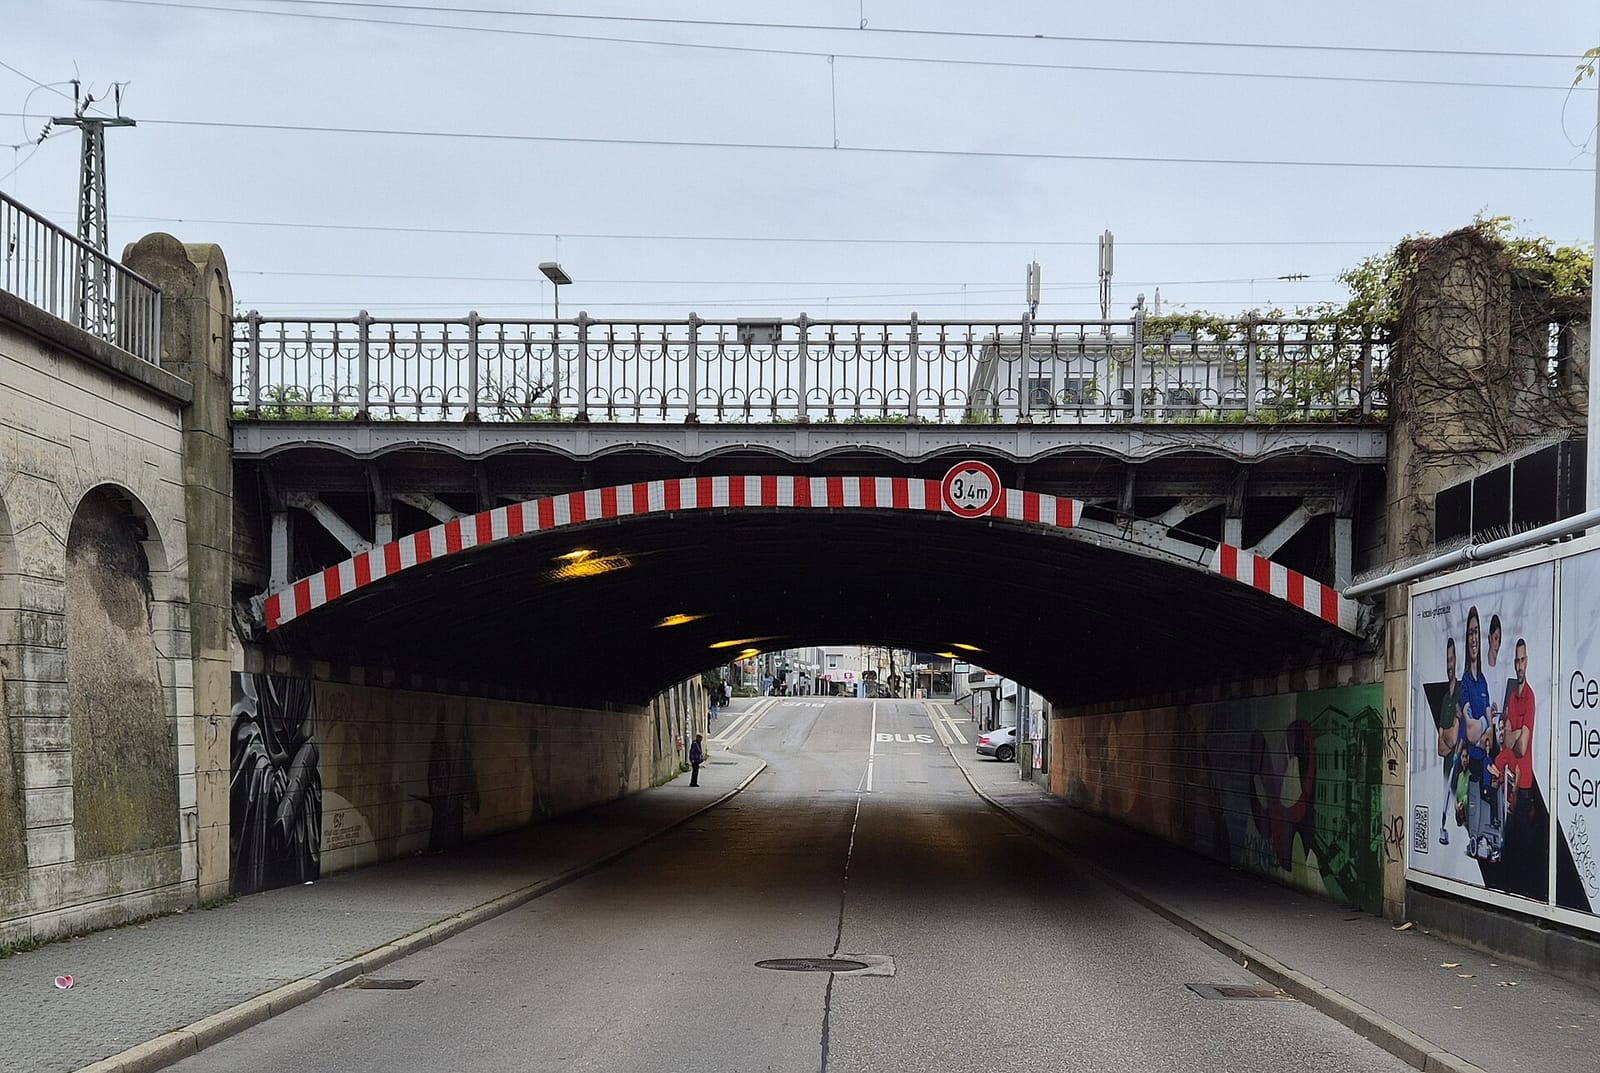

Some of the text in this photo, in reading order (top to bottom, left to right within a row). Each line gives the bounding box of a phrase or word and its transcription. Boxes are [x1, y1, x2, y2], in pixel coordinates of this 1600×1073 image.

[1569, 670, 1599, 709] Ge
[876, 733, 935, 743] BUS
[1569, 720, 1600, 758] Die
